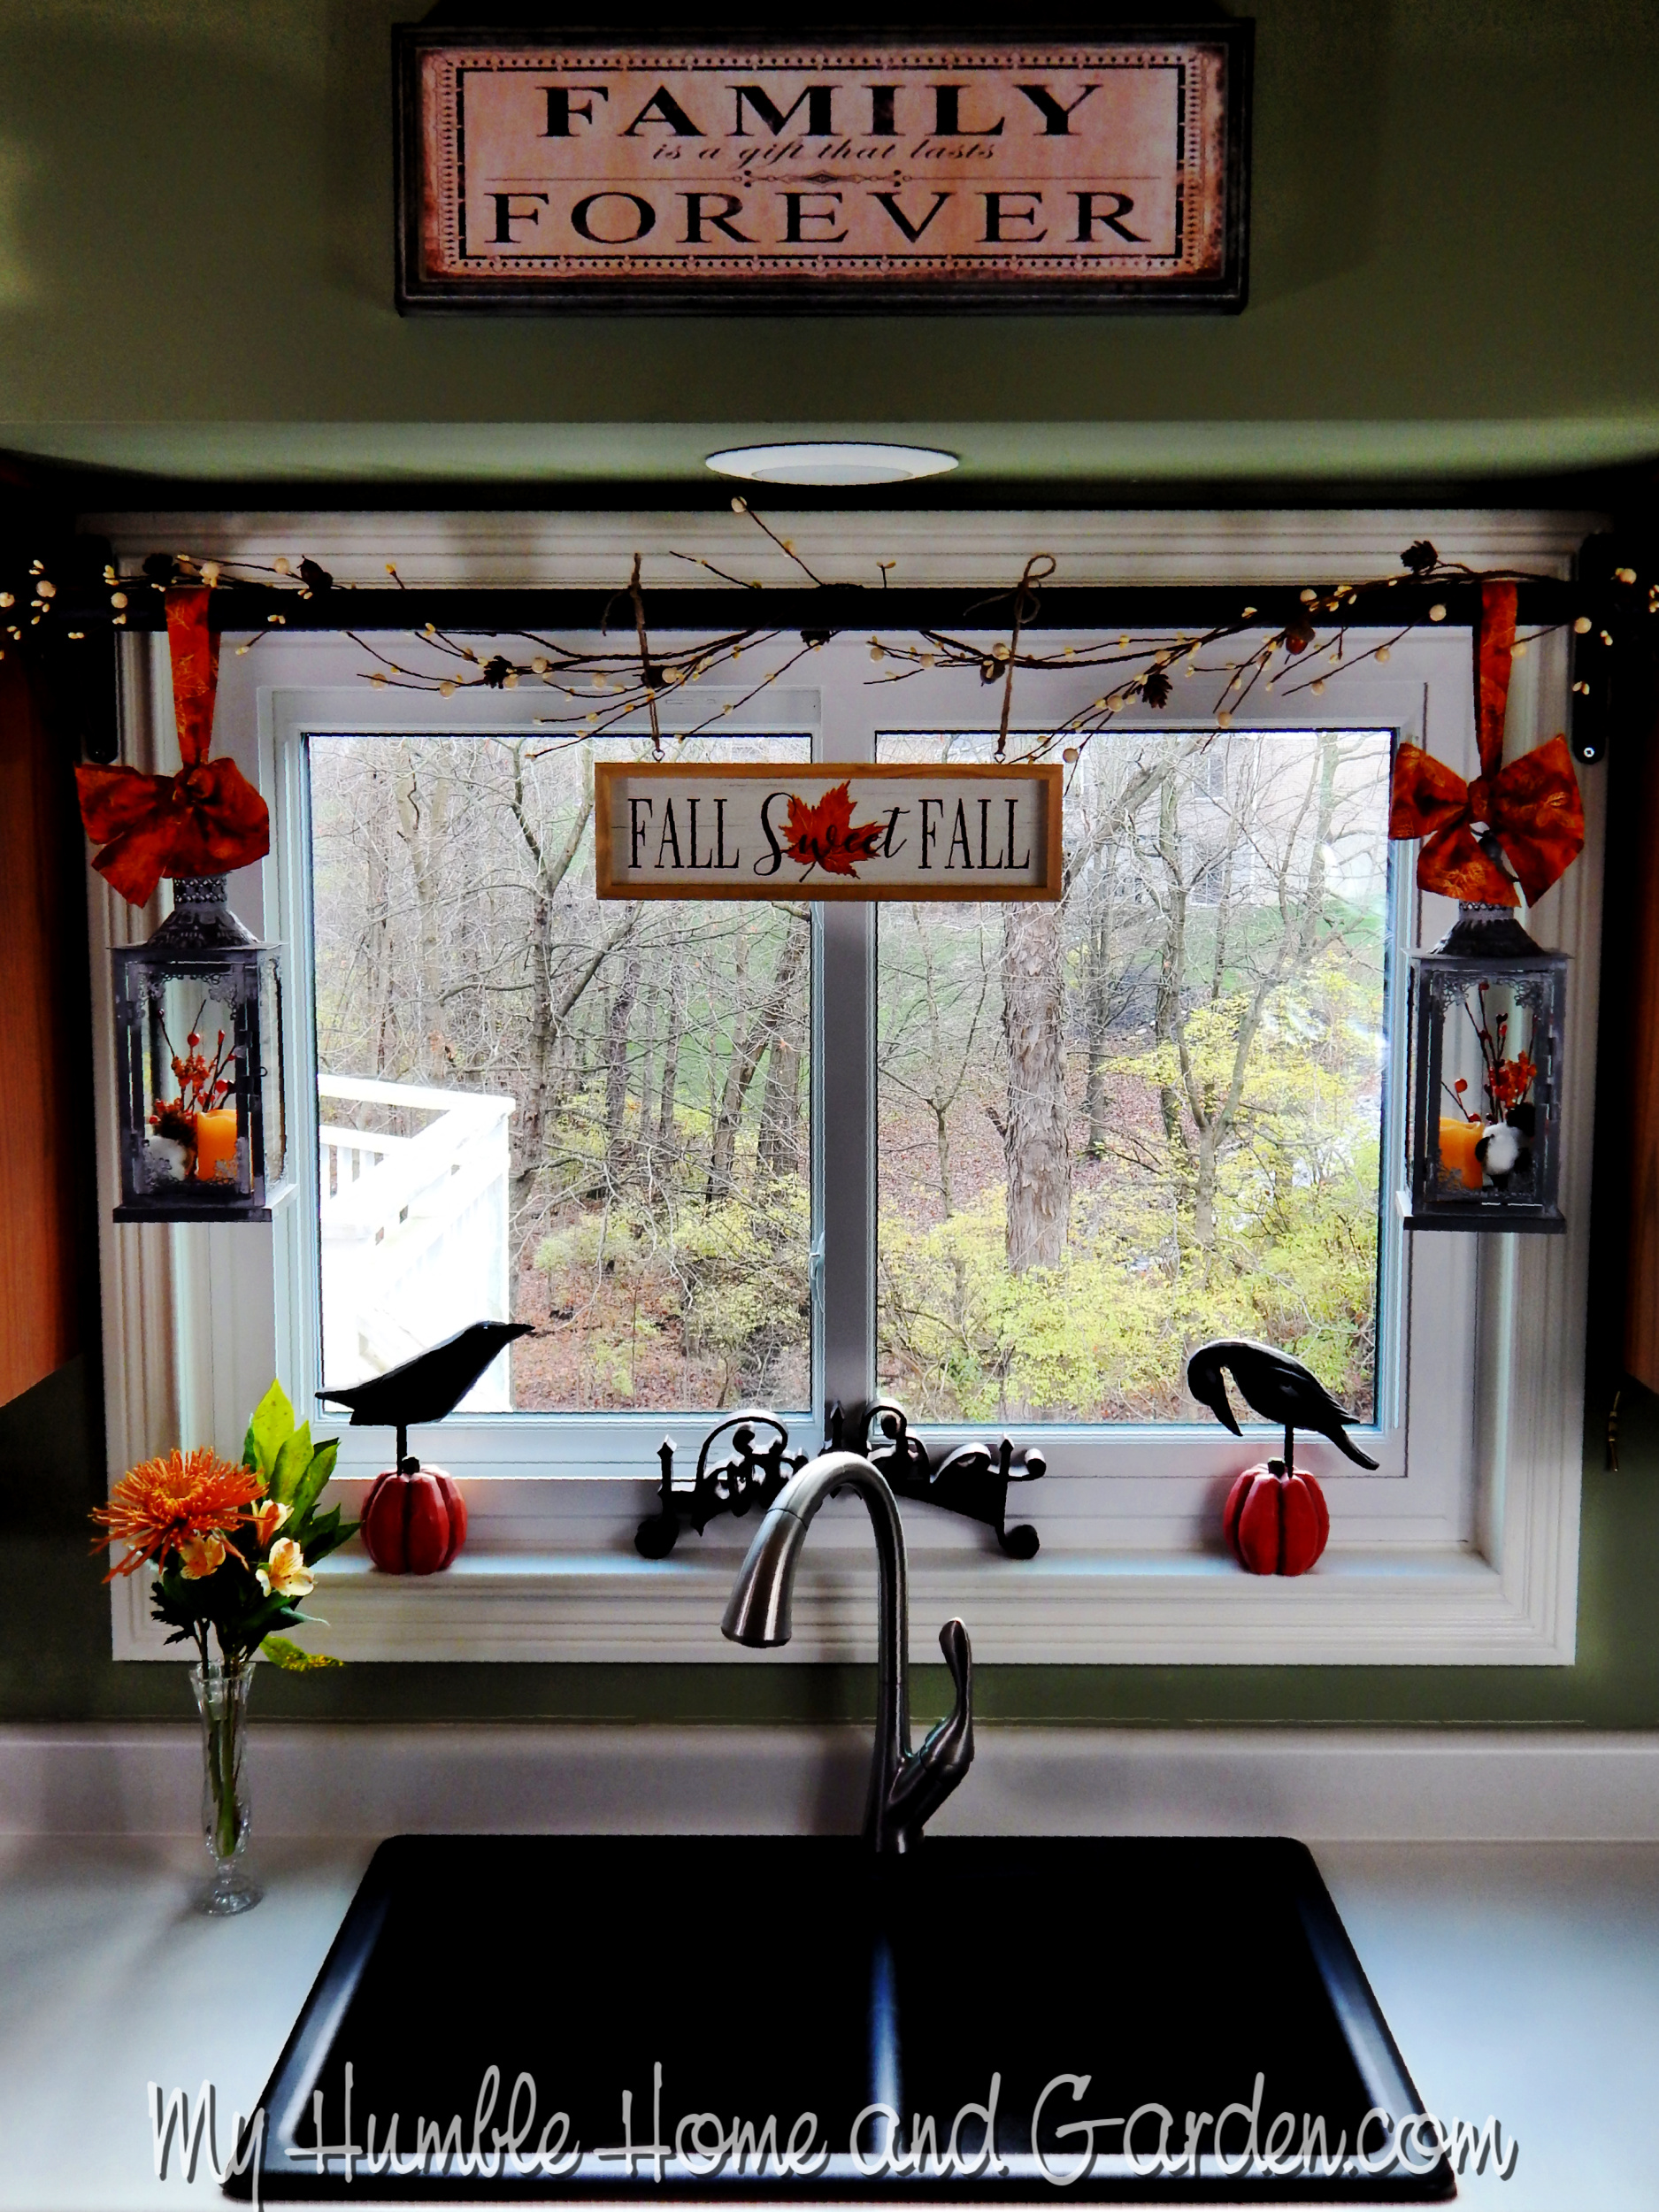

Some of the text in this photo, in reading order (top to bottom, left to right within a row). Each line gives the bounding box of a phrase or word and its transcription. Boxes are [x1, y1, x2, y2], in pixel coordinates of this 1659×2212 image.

[534, 84, 1103, 138] FAMILY
[652, 139, 995, 169] is a gift that lasts
[483, 190, 1151, 244] FOREVER
[627, 792, 1031, 876] FALL Sweet FALL
